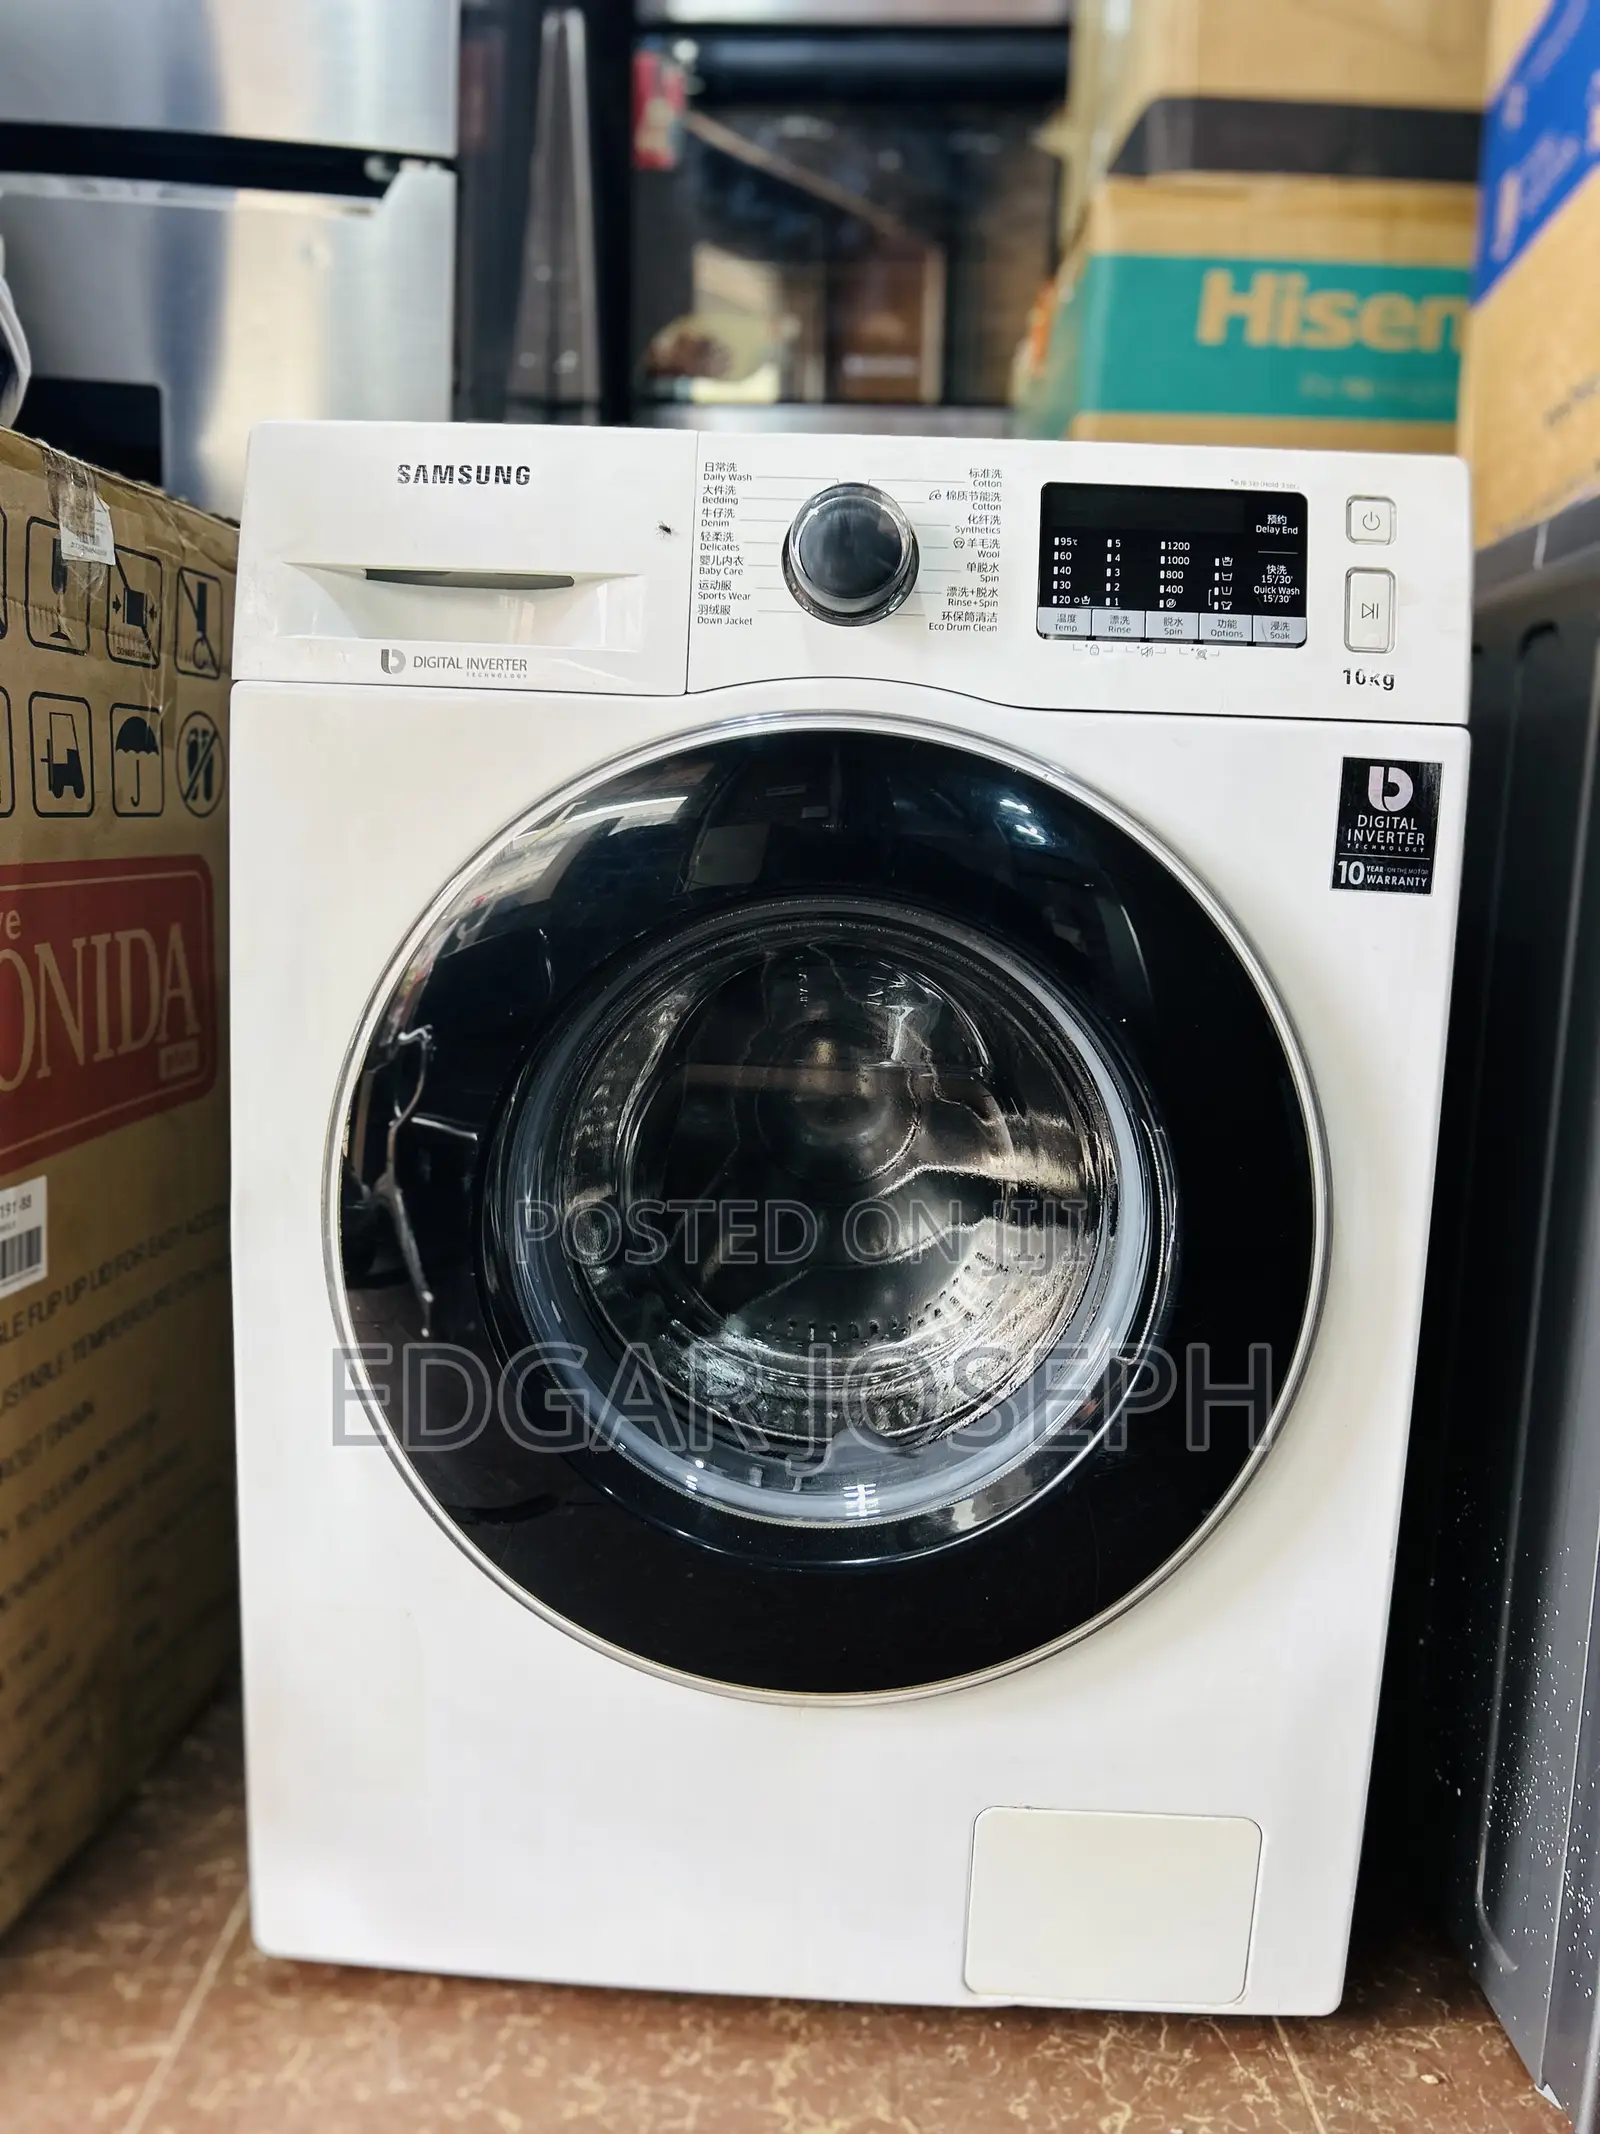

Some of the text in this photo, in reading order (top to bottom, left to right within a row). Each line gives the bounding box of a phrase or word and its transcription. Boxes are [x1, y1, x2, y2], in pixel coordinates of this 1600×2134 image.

[705, 462, 737, 472] 日常洗
[397, 464, 531, 486] SAMSUNG
[704, 473, 726, 482] Daily
[969, 468, 1003, 479] 标准洗
[973, 480, 1002, 488] Cotton
[703, 485, 736, 495] 大件洗
[702, 496, 739, 505] Bedding
[946, 490, 1002, 502] 棉质节能洗
[972, 502, 1002, 511] Cotton
[702, 507, 735, 519] 牛仔洗
[701, 519, 729, 527] Denim
[968, 514, 1002, 525] 化纤洗
[1267, 514, 1287, 525] 预约
[955, 525, 1001, 534] Synthetics
[1255, 525, 1298, 535] Delay End
[700, 531, 734, 542] 轻柔洗
[700, 543, 740, 551] Delicates
[967, 538, 1001, 549] 羊毛洗
[1115, 539, 1121, 548] 5
[1167, 542, 1190, 550] 1200
[978, 550, 1000, 558] Wool
[1059, 552, 1072, 560] 60
[1114, 553, 1121, 562] 4
[699, 555, 744, 566] 婴儿内衣
[1167, 556, 1190, 565] 1000
[699, 567, 743, 576] Baby Care
[966, 562, 1000, 573] 单脱水
[1059, 566, 1072, 575] 40
[1266, 564, 1287, 575] 快洗
[1114, 568, 1121, 577] 3
[1166, 570, 1184, 579] 800
[980, 574, 999, 583] Spin
[699, 580, 732, 591] 运动服
[1059, 581, 1071, 589] 30
[1114, 583, 1120, 591] 2
[1165, 585, 1184, 594] 400
[1253, 585, 1300, 595] Quick Wash
[698, 592, 751, 601] Sports Wear
[1058, 595, 1071, 604] 20
[1114, 597, 1119, 606] 1
[698, 604, 731, 615] 羽绒服
[697, 616, 753, 625] Down Jacket
[1056, 612, 1077, 623] 温度
[1163, 616, 1184, 627] 脱水
[928, 622, 997, 632] Eco Drum Clean
[1217, 618, 1237, 629] 功能
[1270, 621, 1290, 631] 浸洗
[1109, 625, 1131, 634] Rinse
[1165, 627, 1183, 636] Spin
[1211, 629, 1243, 638] Options
[1269, 631, 1291, 640] Soak
[413, 656, 528, 671] DIGITAL INVERTER
[466, 671, 528, 679] TECHNOLOGY
[1343, 668, 1395, 691] 10kg
[1357, 814, 1418, 831] DIGITAL
[1347, 829, 1425, 845] INVERTER
[1346, 843, 1424, 853] TECHNOLOGY
[1337, 860, 1365, 885] 10
[1366, 865, 1384, 873] YEAR
[1366, 874, 1428, 887] WARRANTY
[0, 921, 203, 1092] ONIDA
